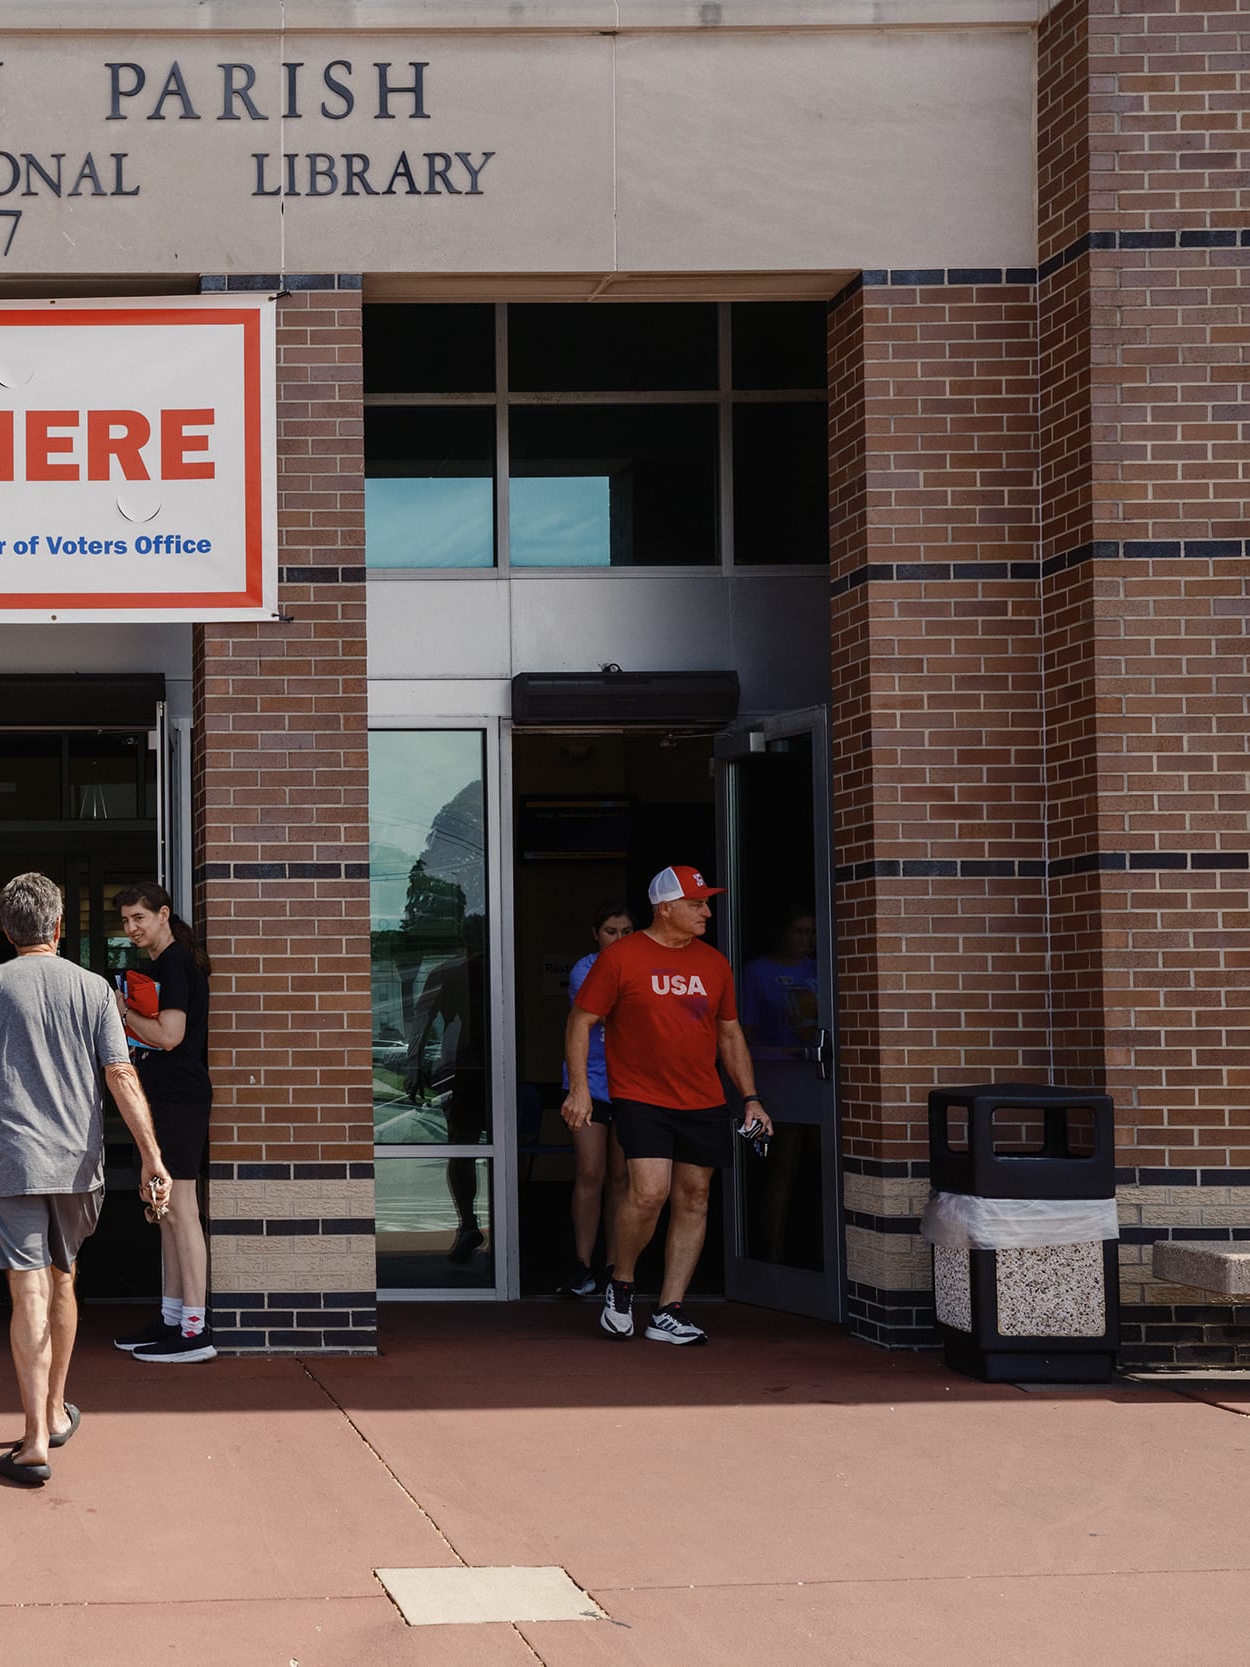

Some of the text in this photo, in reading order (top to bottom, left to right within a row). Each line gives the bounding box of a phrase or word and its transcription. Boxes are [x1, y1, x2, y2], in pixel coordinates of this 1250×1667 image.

[104, 59, 432, 121] PARISH
[251, 151, 497, 197] LIBRARY
[13, 535, 42, 556] of
[46, 536, 129, 556] Voters
[135, 535, 213, 556] Office
[651, 975, 708, 997] USA
